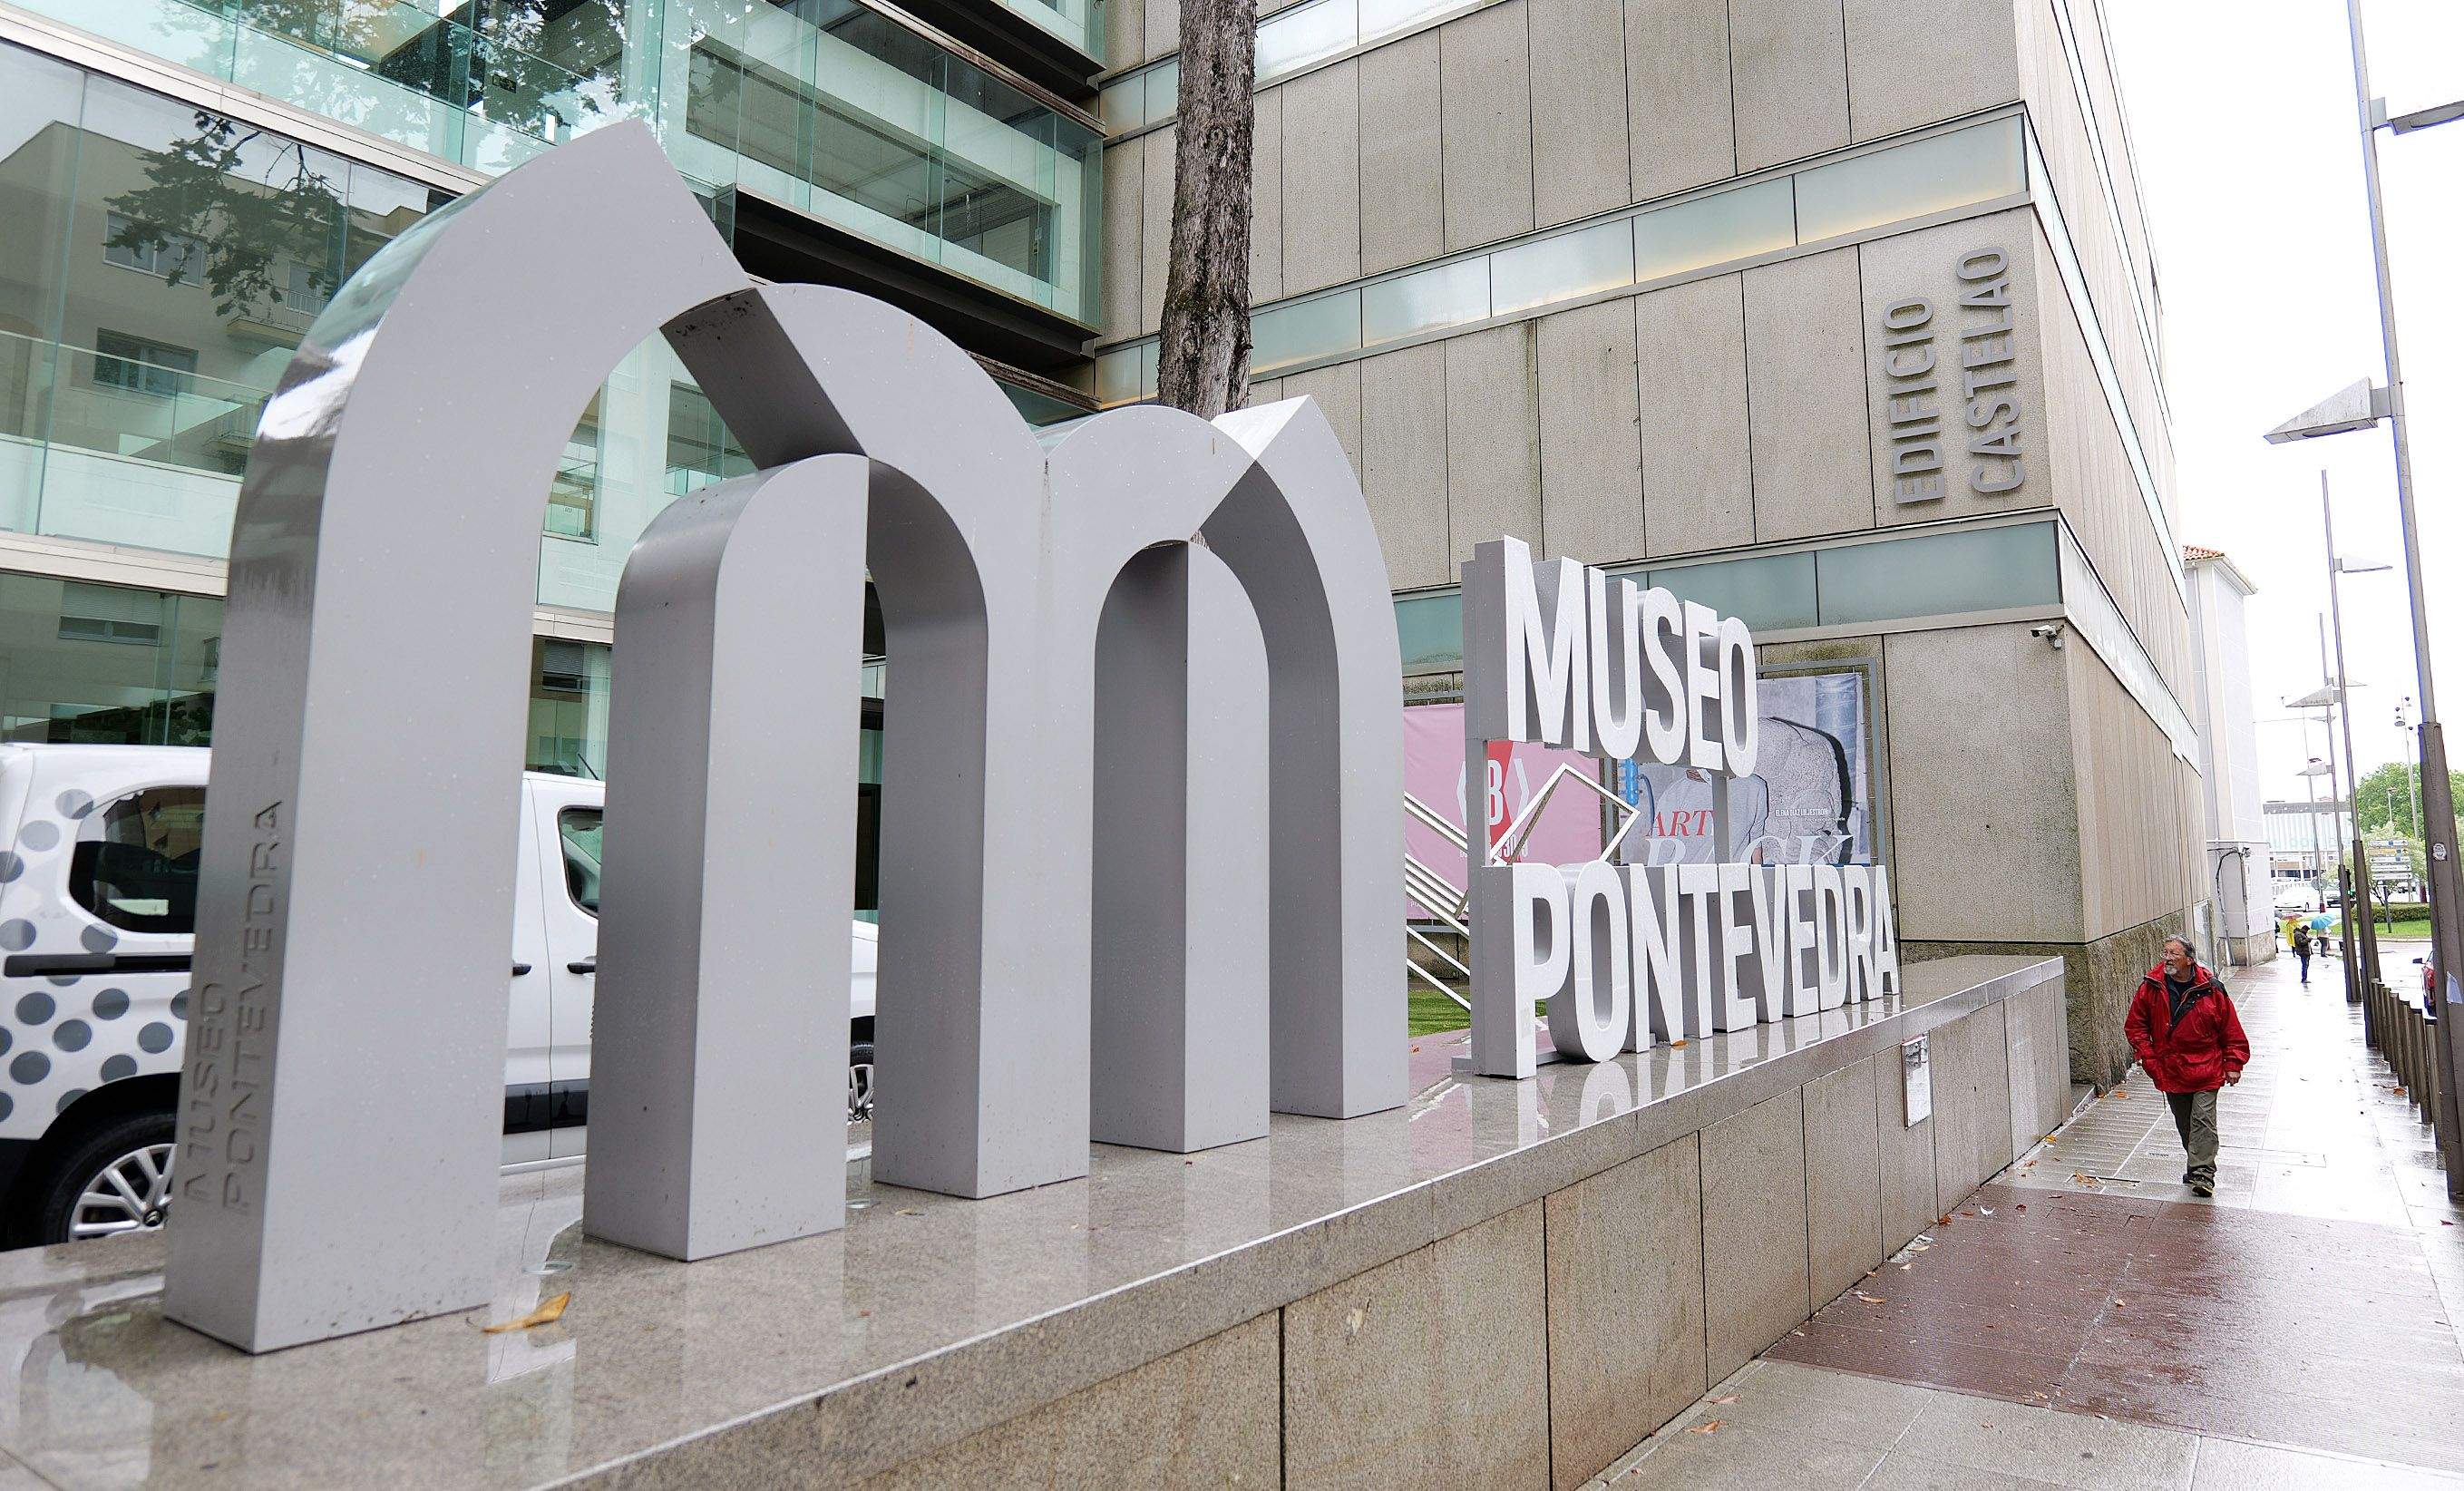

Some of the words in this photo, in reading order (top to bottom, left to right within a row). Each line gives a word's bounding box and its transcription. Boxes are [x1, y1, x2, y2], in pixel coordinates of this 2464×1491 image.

[1883, 296, 1946, 504] EDIFICIO
[1955, 246, 2026, 493] CASTELAO
[1503, 534, 1758, 779] MUSEO
[221, 800, 283, 1218] PONTEVEDRA
[1512, 860, 1900, 1080] PONTEVEDRA
[184, 982, 227, 1204] MUSEO
